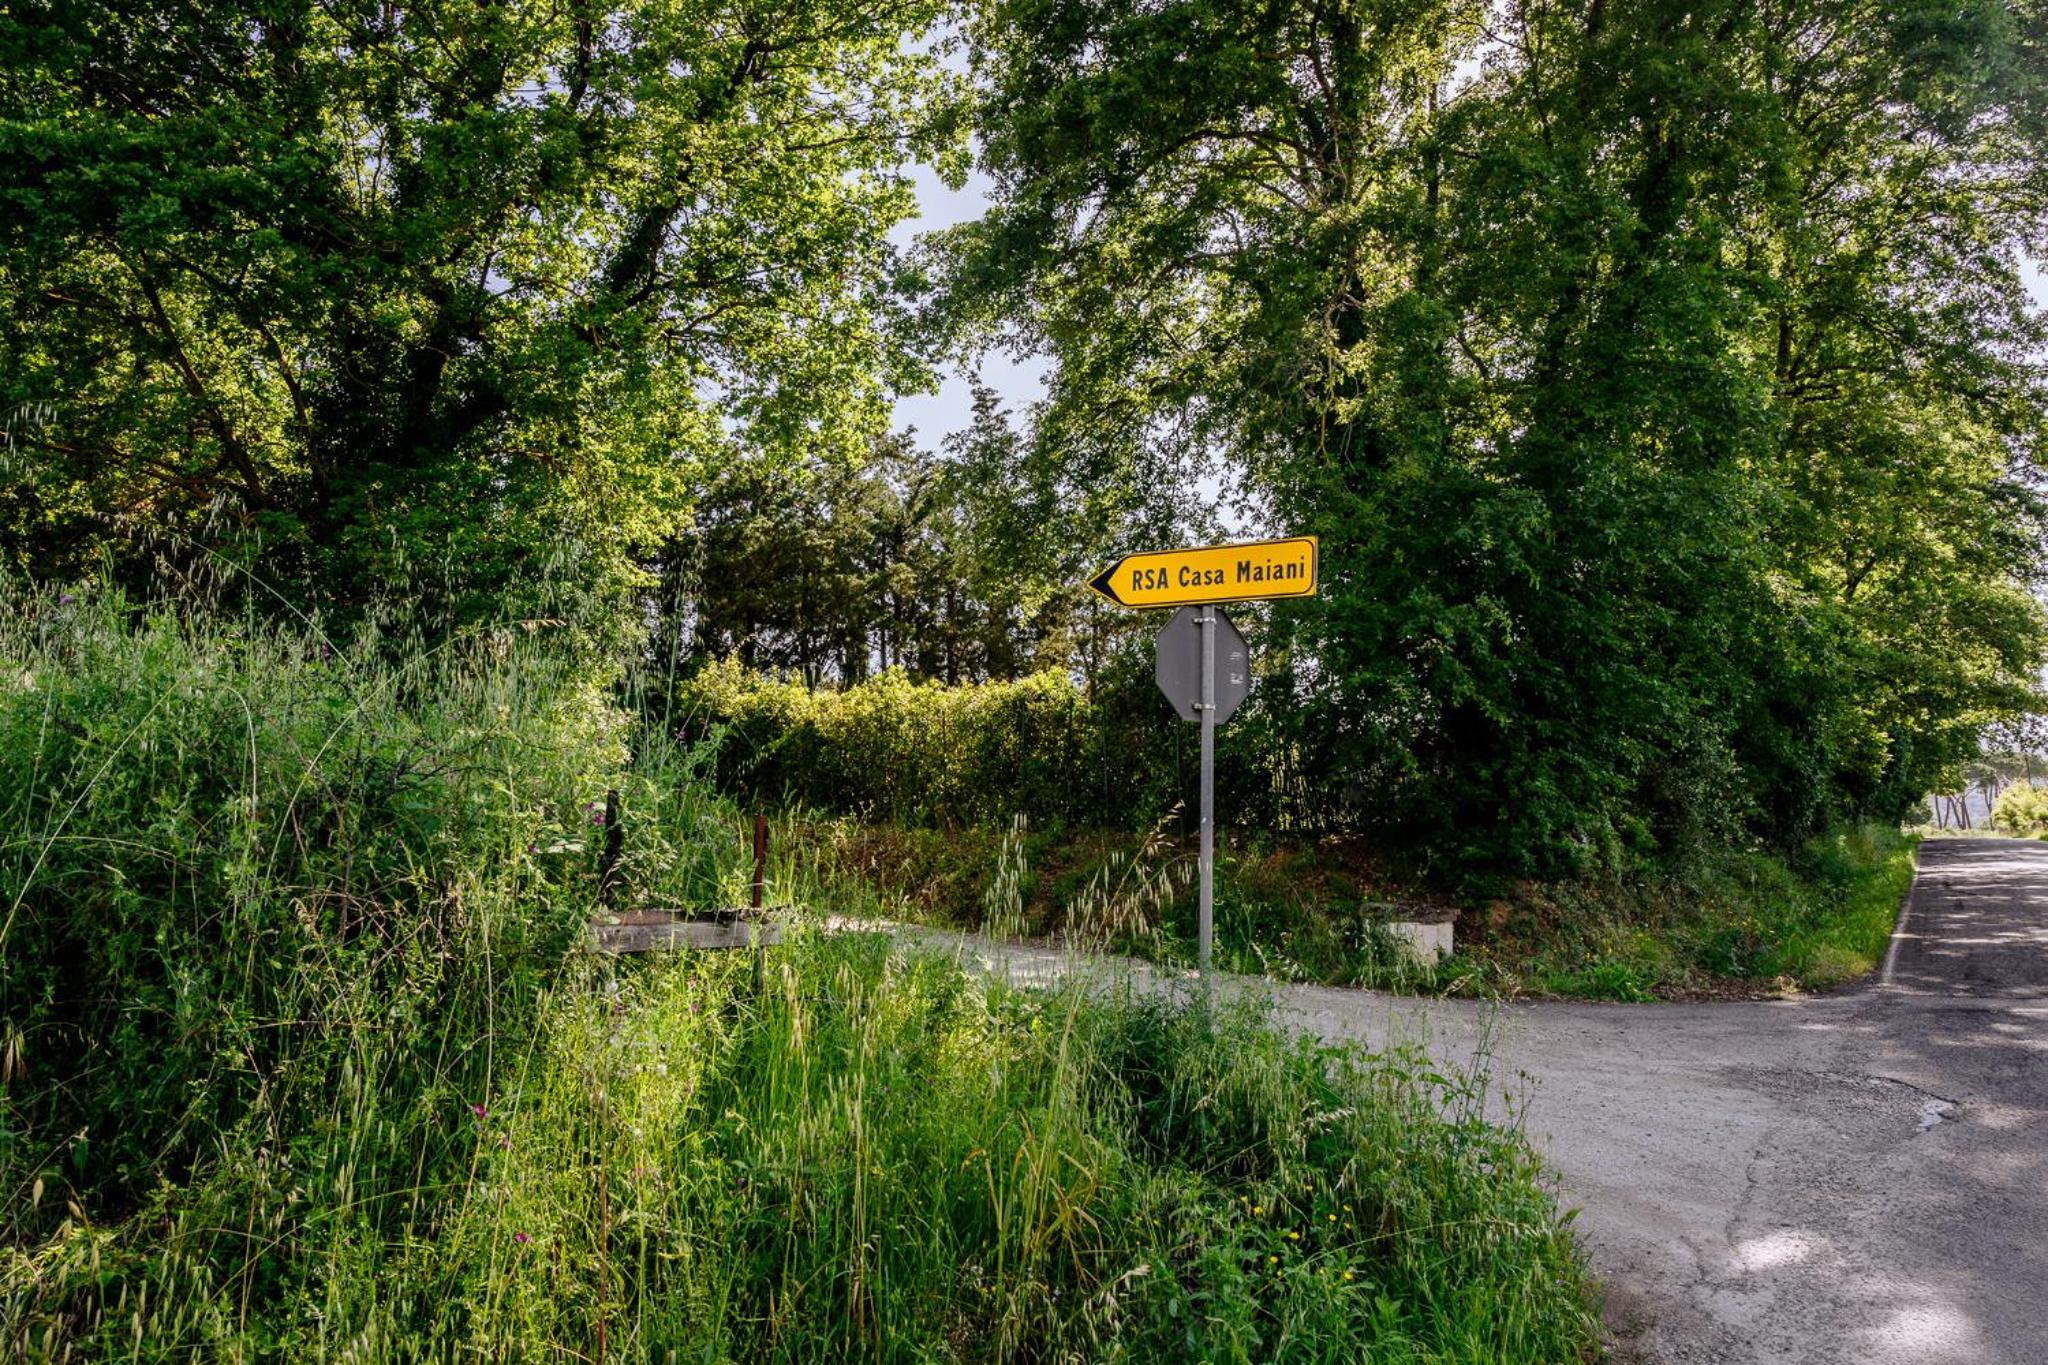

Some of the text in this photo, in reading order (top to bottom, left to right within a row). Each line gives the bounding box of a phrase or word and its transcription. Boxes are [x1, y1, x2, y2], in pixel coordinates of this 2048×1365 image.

[1132, 555, 1305, 591] RSA Casa Maiani
